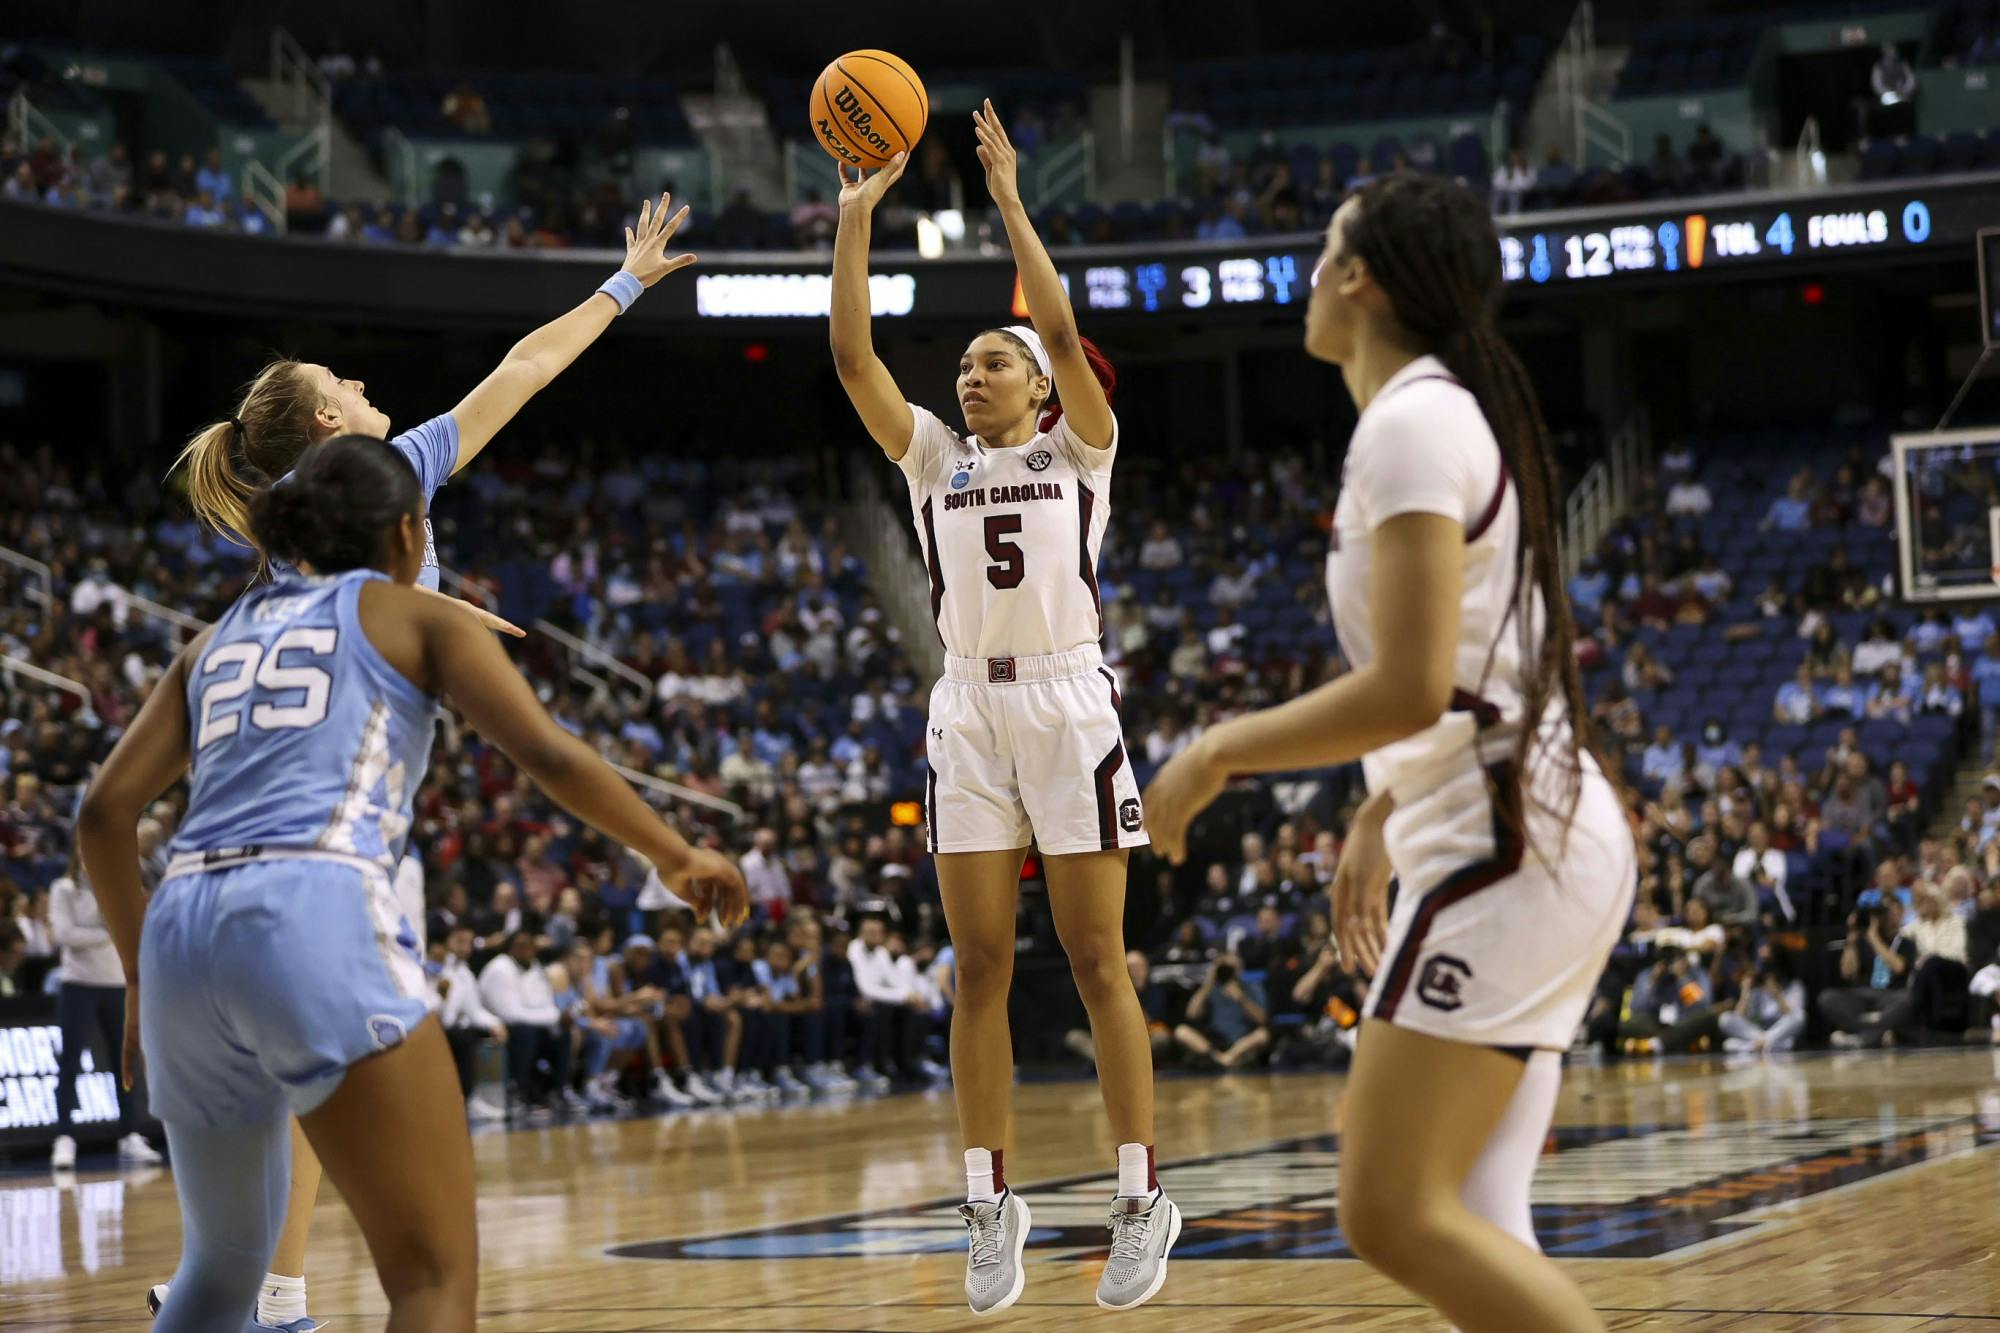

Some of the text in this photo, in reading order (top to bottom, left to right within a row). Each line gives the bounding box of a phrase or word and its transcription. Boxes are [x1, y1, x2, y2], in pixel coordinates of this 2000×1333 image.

[817, 118, 862, 164] NCAA
[834, 85, 890, 153] Wilson
[1766, 213, 1794, 254] 4
[1808, 210, 1887, 247] FOULS
[1903, 201, 1930, 242] 0
[1565, 233, 1612, 277] 12
[1182, 266, 1211, 306] 3
[1028, 451, 1052, 470] SEC
[944, 483, 1064, 511] SOUTH CAROLINA
[983, 513, 1025, 590] 5
[196, 626, 339, 752] 25
